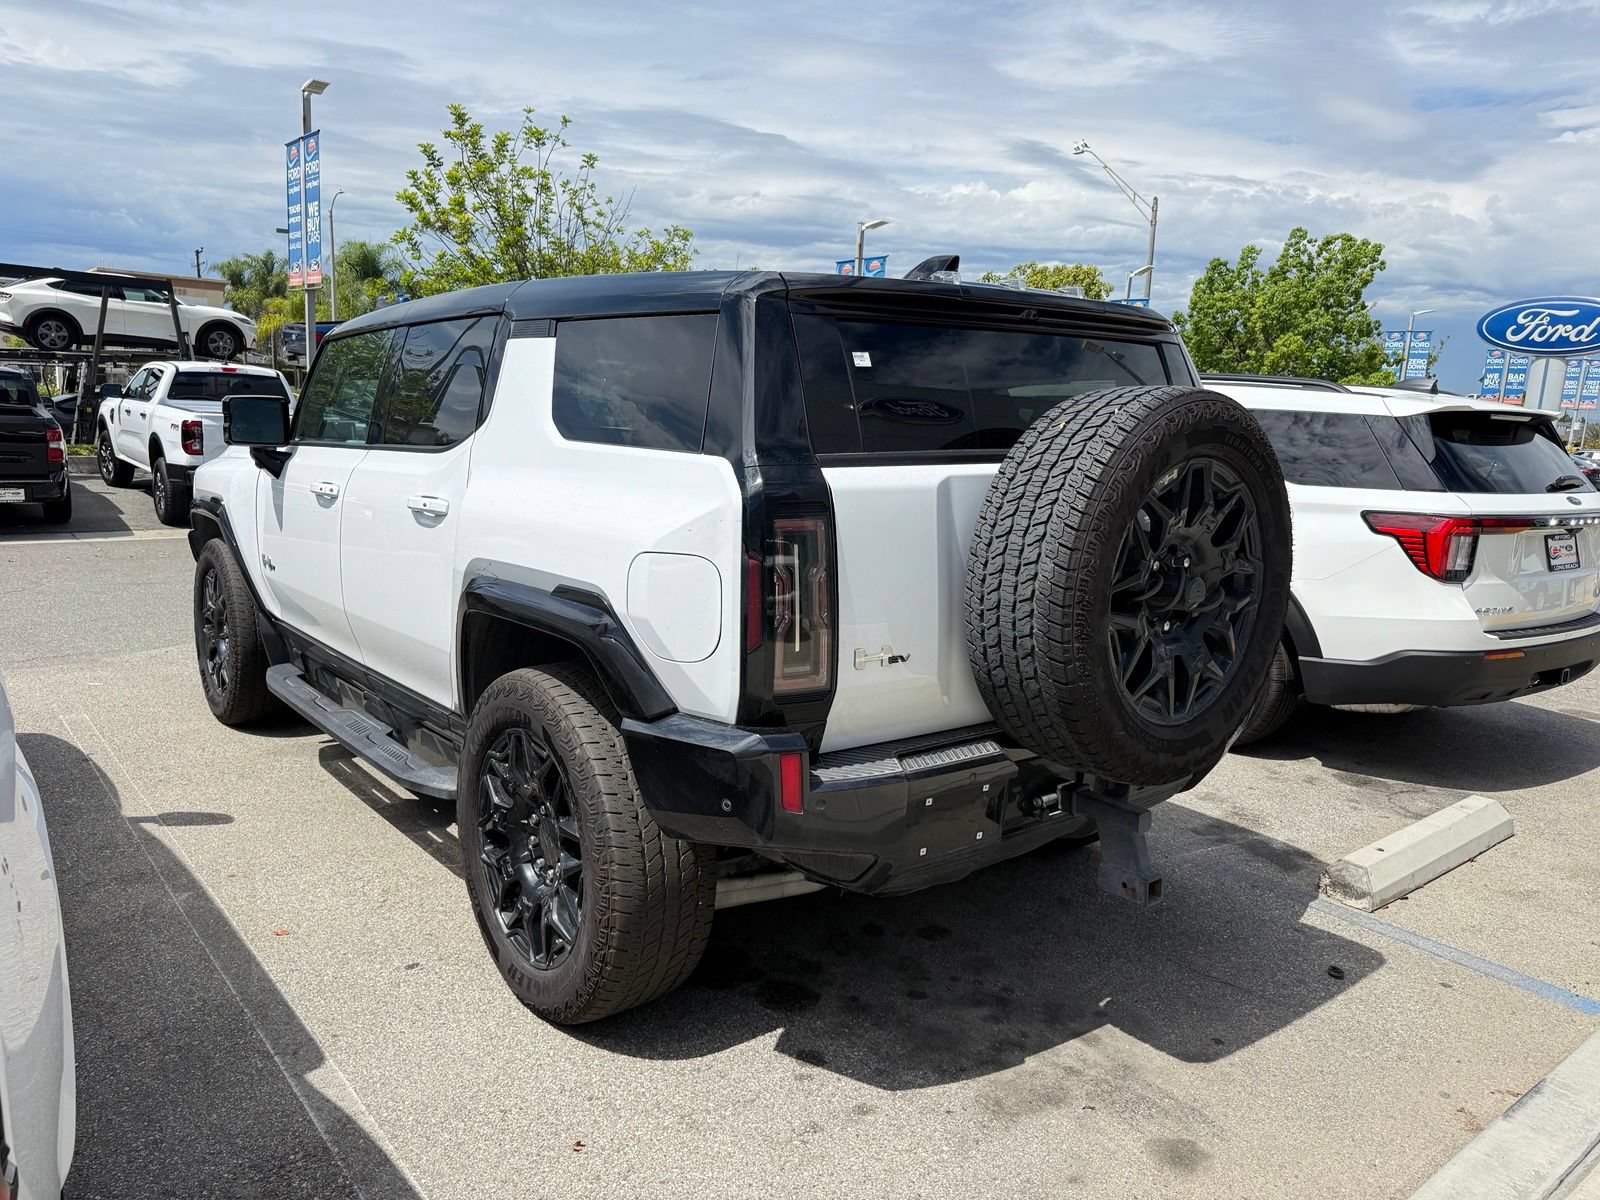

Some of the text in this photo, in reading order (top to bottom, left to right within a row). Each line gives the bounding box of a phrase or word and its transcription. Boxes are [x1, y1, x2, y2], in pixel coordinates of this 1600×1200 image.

[288, 166, 301, 181] FORD
[305, 160, 319, 175] FORD
[307, 201, 319, 217] WE
[307, 216, 320, 232] BUY
[307, 230, 320, 244] CARS
[1505, 308, 1600, 342] Ford
